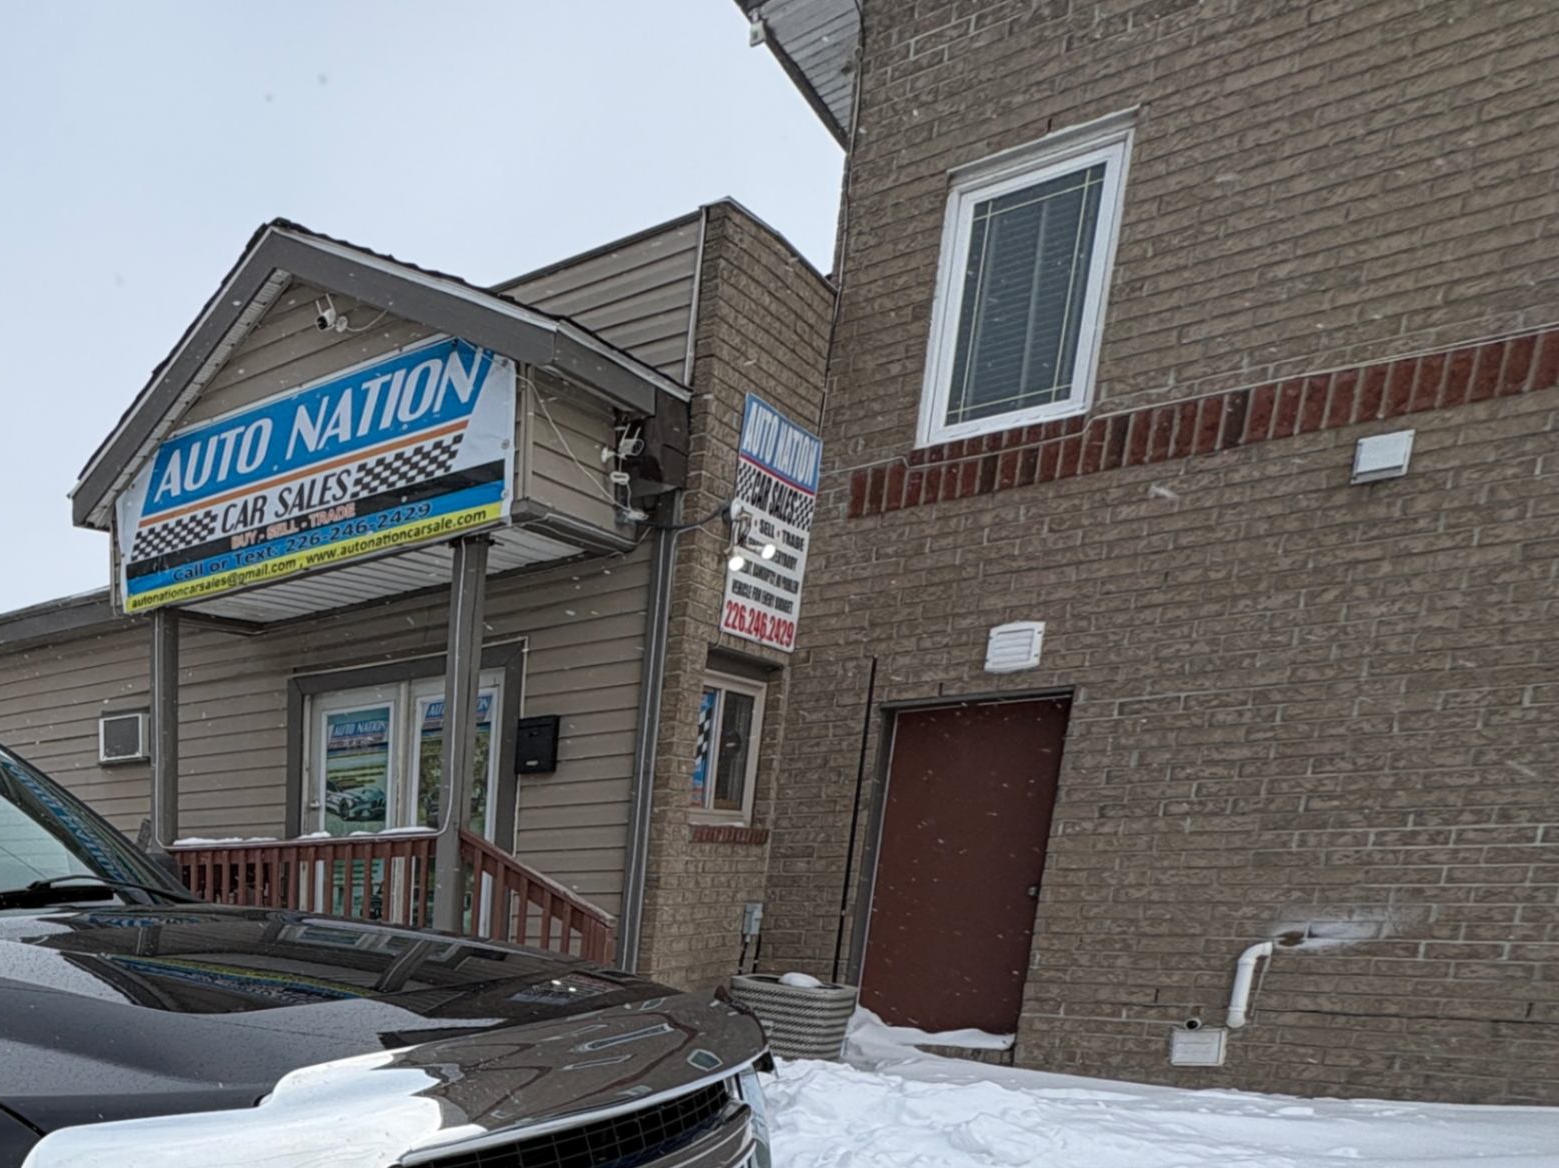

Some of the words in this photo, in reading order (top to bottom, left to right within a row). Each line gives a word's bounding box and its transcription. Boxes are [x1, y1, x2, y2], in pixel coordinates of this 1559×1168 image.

[154, 417, 273, 503] AUTO
[285, 347, 482, 460] NATION
[743, 401, 779, 464] AUTO
[773, 420, 819, 487] NATION
[221, 494, 268, 534] CAR
[274, 469, 352, 519] SALES
[230, 529, 258, 549] BUY
[266, 519, 300, 539] SELL
[308, 503, 356, 528] TRADE
[750, 470, 772, 512] CAR
[768, 480, 798, 525] SALES
[131, 558, 297, 608] autonationcarsales@gmail.com
[305, 509, 487, 565] www.autonationcarsale.com
[173, 564, 204, 582] Call
[209, 560, 229, 573] or
[285, 503, 432, 551] 226-246-2429
[724, 600, 794, 648] 226.246.2429
